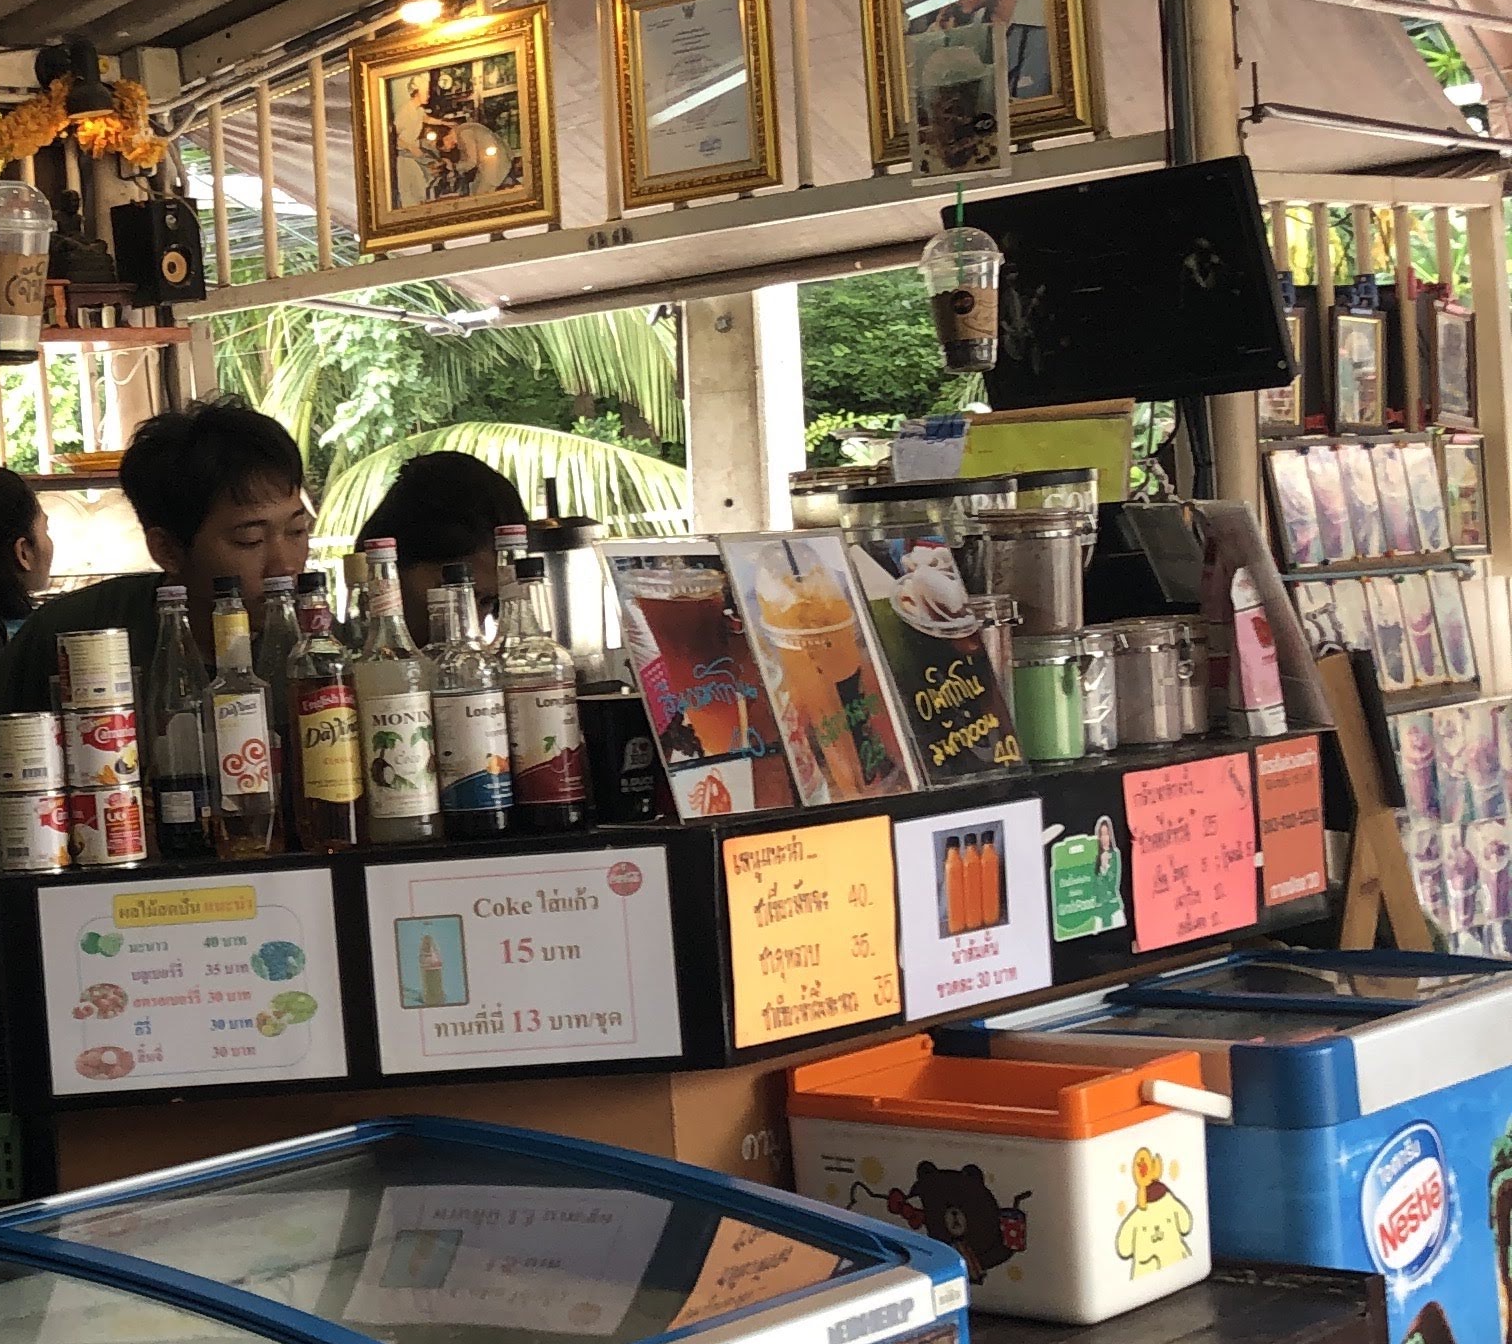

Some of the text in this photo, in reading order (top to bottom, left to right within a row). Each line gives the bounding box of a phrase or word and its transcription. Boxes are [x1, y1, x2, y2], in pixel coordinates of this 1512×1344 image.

[371, 709, 433, 728] MONIN
[993, 734, 1022, 768] 40
[473, 897, 532, 918] Coke
[500, 937, 581, 964] 15 บาท
[434, 1003, 505, 1038] ทานที่นี่
[512, 1009, 542, 1033] 13
[1378, 1170, 1442, 1259] Nestlé
